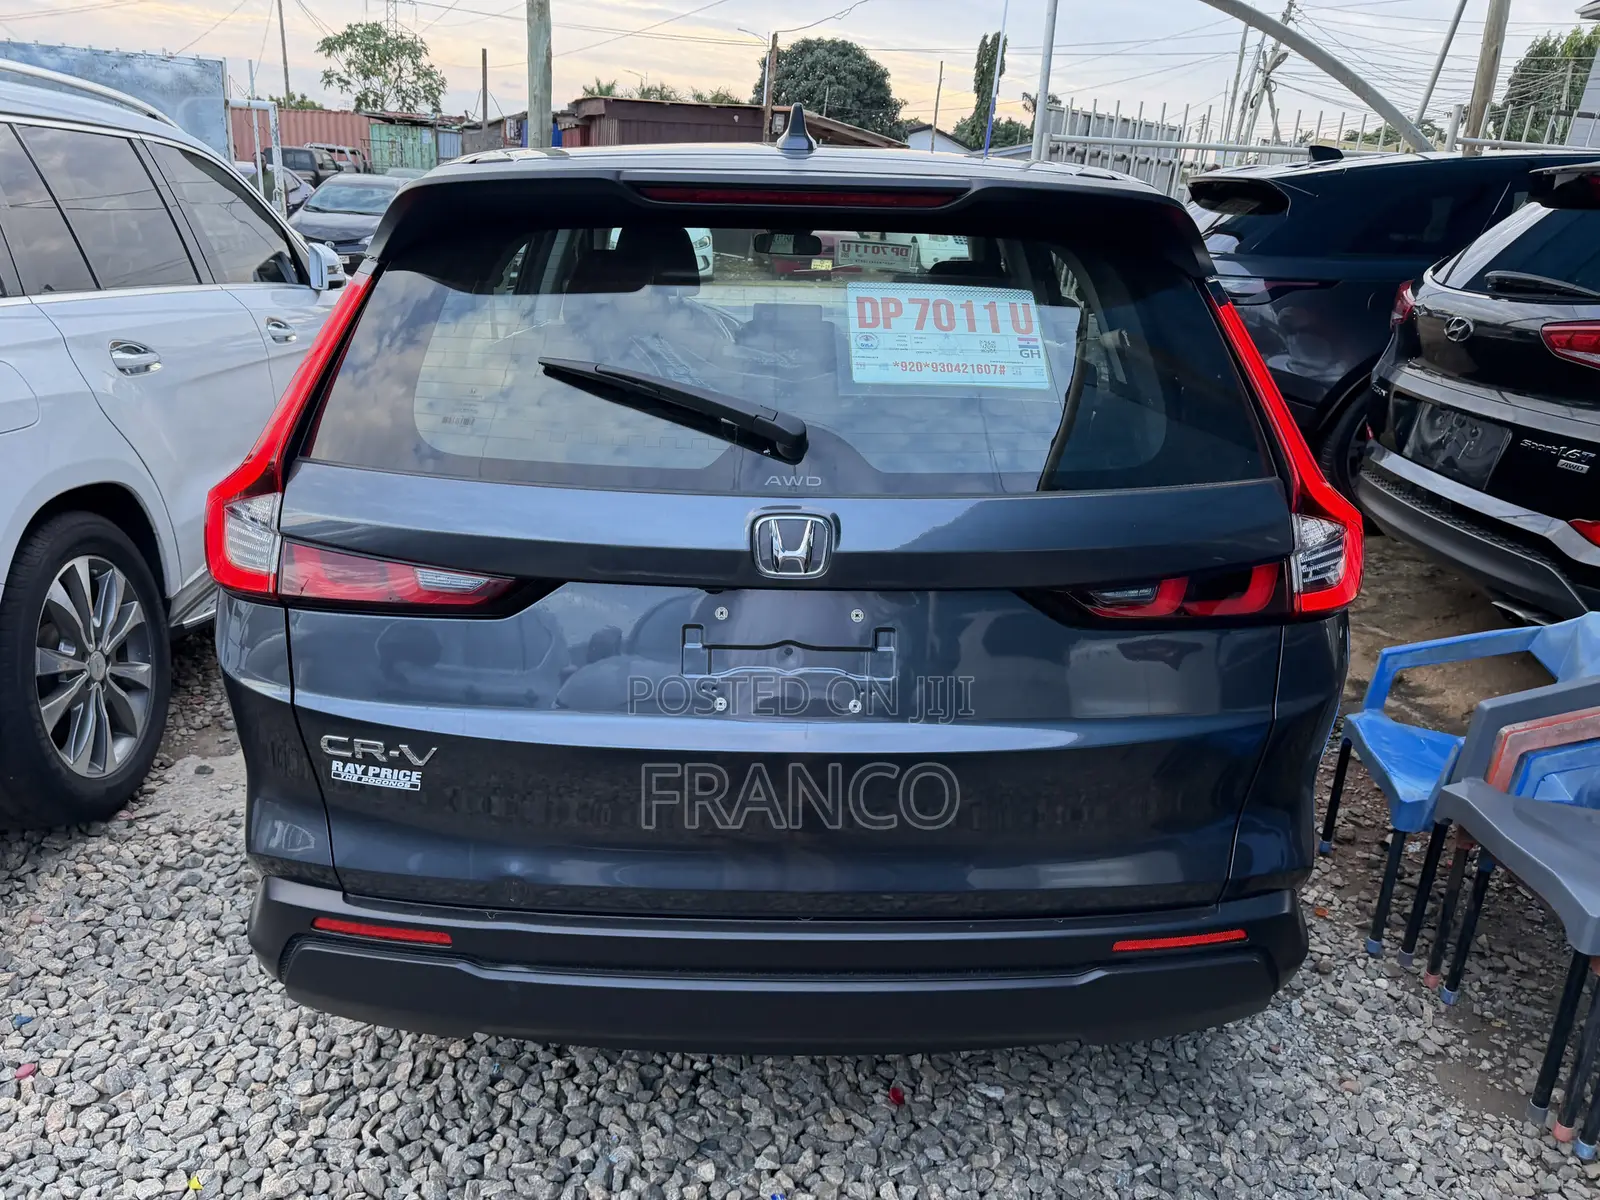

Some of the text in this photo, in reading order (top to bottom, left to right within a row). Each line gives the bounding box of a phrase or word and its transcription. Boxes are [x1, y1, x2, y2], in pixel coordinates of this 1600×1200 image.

[856, 296, 1034, 335] DP 7011 U
[1019, 349, 1041, 359] GH
[1561, 461, 1584, 472] AWD
[764, 475, 822, 486] AWD
[320, 735, 437, 766] CR-V
[331, 760, 422, 783] RAY PRICE
[340, 773, 358, 781] THE
